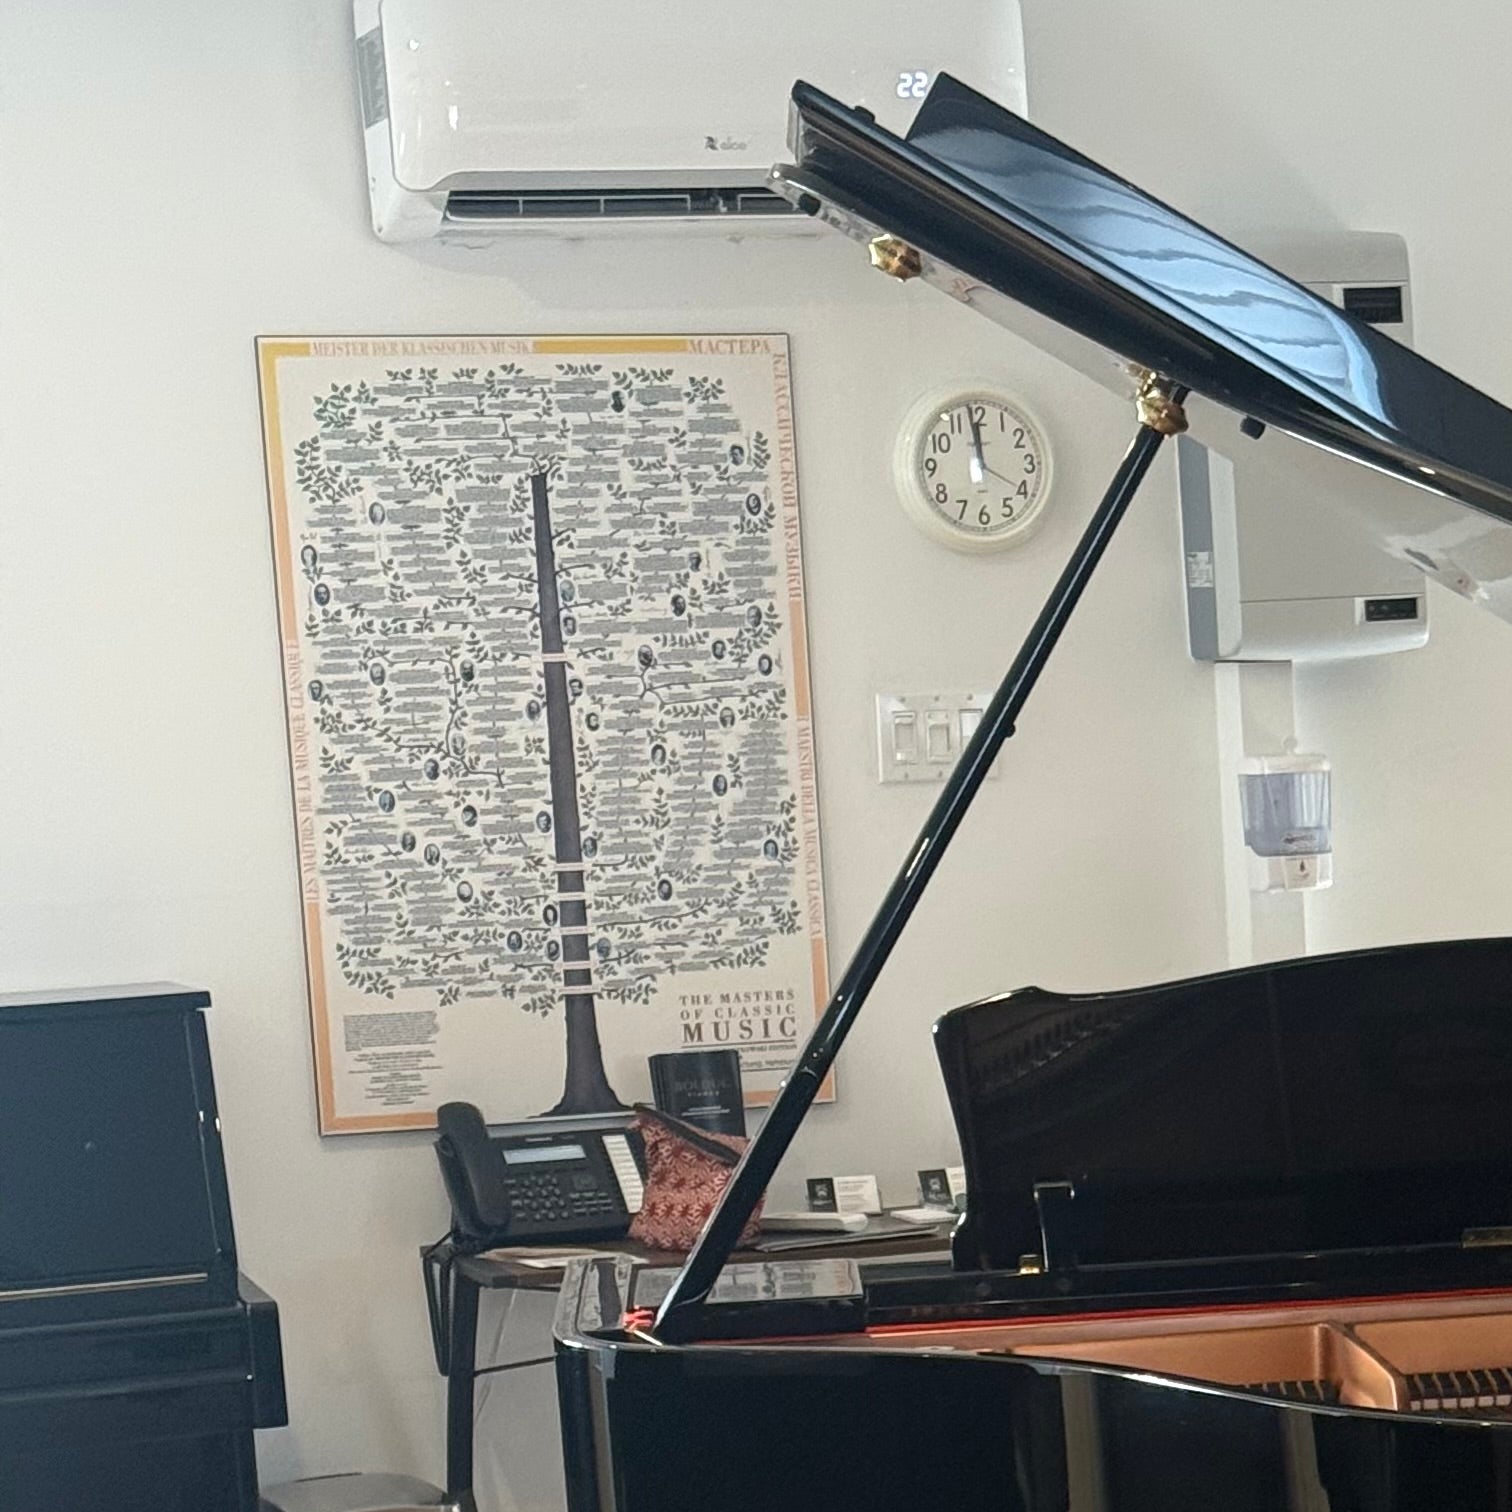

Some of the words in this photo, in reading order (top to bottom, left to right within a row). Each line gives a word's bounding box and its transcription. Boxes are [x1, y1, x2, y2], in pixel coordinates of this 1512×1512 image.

[897, 71, 928, 98] 22
[950, 413, 962, 435] 11
[1000, 412, 1005, 432] 1
[931, 432, 951, 454] 10
[1012, 428, 1026, 449] 2
[924, 458, 937, 478] 9
[1023, 454, 1036, 474] 3
[936, 483, 948, 504] 8
[1016, 479, 1028, 499] 4
[956, 499, 968, 520] 7
[979, 504, 990, 525] 6
[1001, 497, 1013, 517] 5
[680, 994, 713, 1006] THE
[720, 989, 795, 1004] MASTERS
[680, 1009, 703, 1021] OF
[714, 1004, 796, 1019] CLASSIC
[682, 1016, 797, 1043] MUSIC
